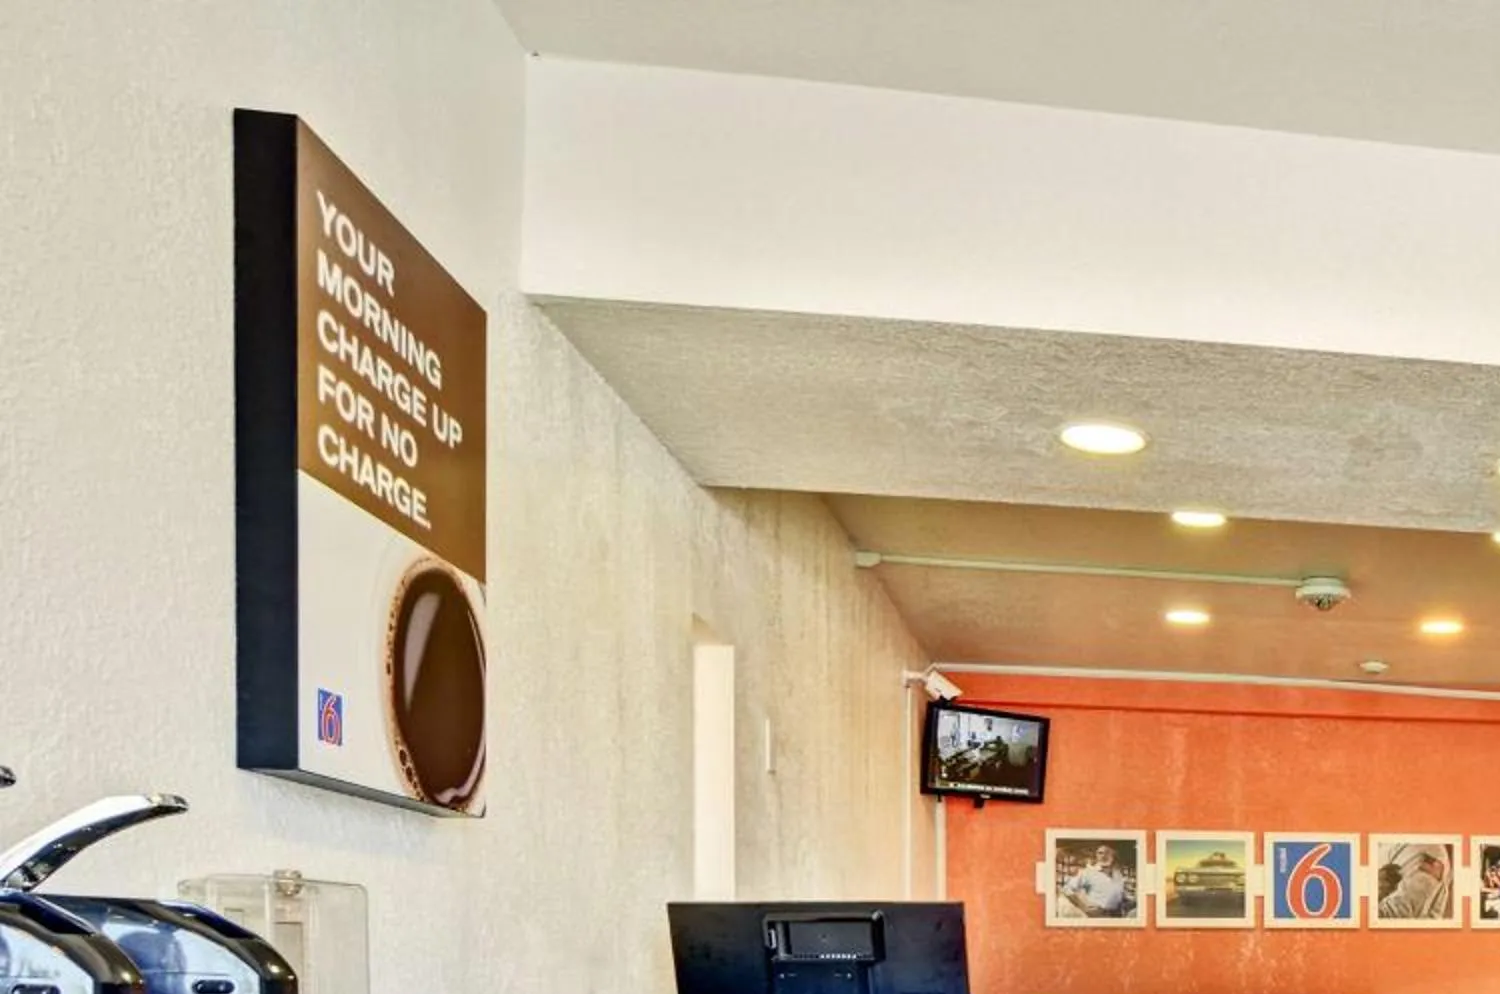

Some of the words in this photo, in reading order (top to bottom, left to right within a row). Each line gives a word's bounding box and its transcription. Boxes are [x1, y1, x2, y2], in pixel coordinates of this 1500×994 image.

[317, 190, 395, 298] YOUR
[318, 248, 441, 391] MORNING
[317, 310, 426, 427] CHARGE
[432, 403, 463, 449] UP
[318, 364, 375, 440] FOR
[381, 413, 418, 467] NO
[318, 423, 431, 530] CHARGE.
[1285, 843, 1343, 918] 6
